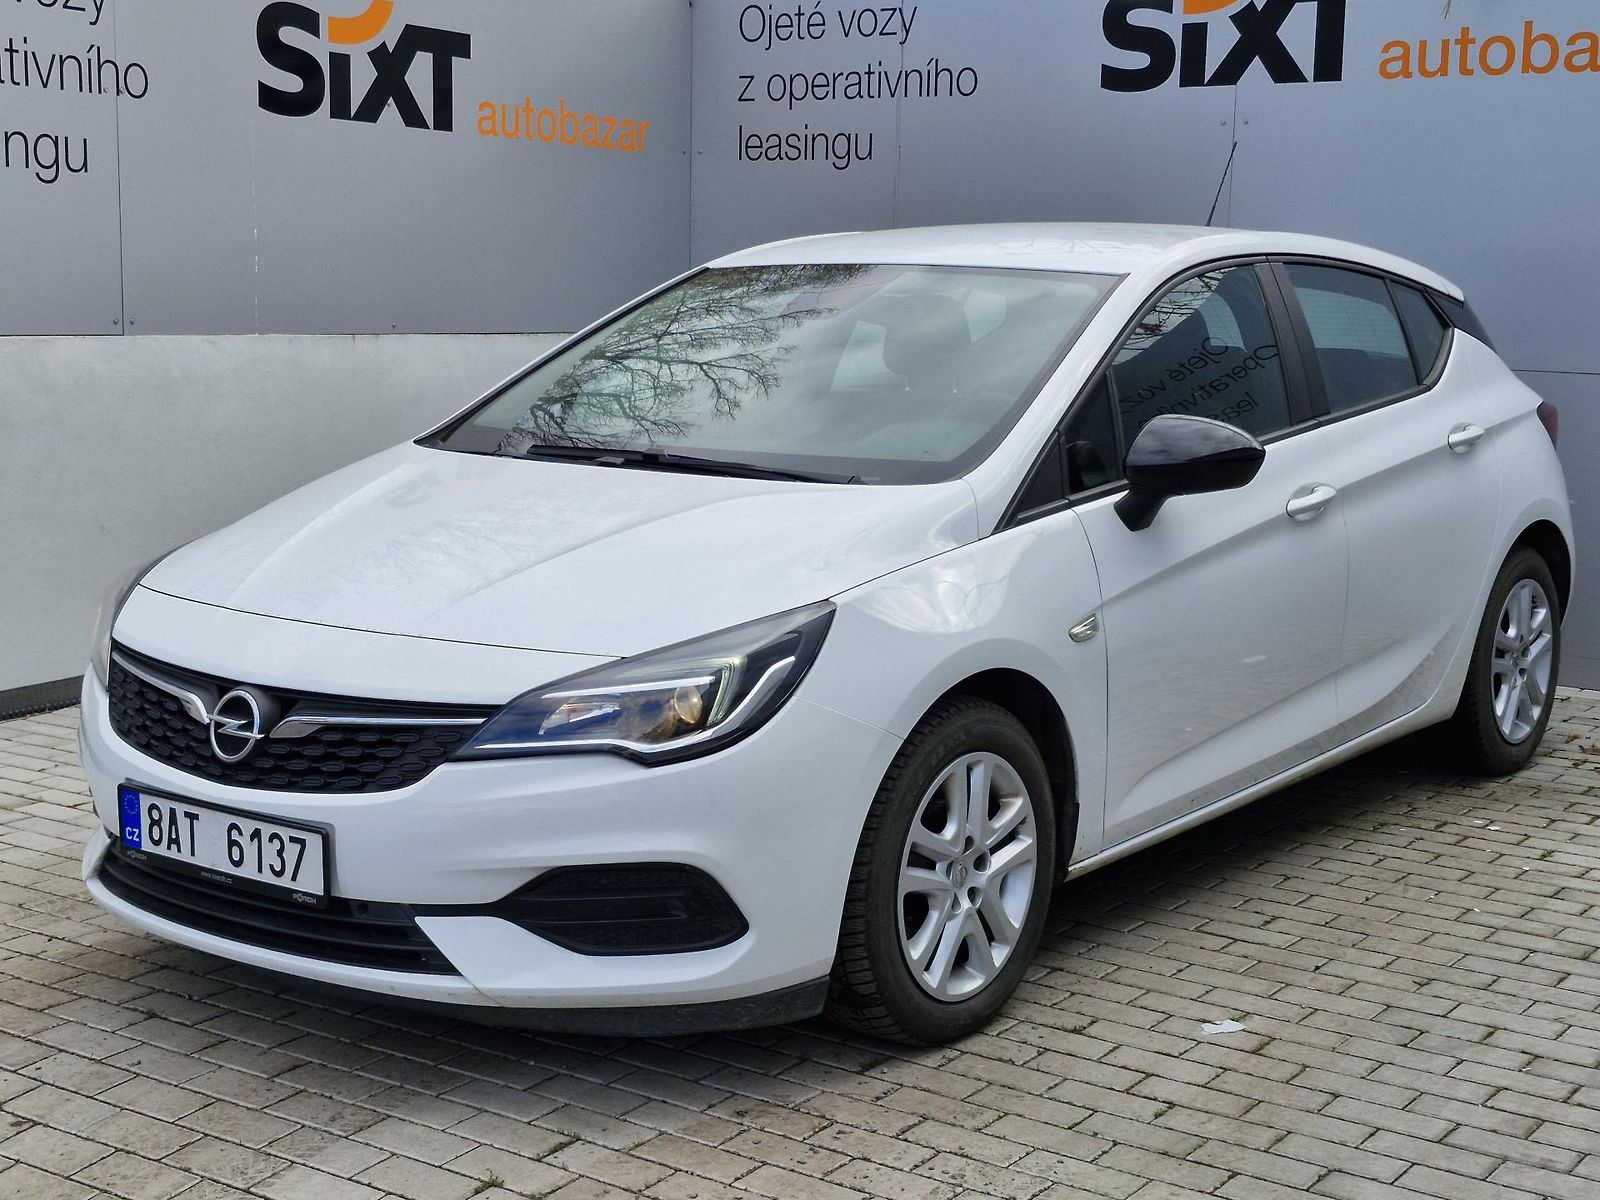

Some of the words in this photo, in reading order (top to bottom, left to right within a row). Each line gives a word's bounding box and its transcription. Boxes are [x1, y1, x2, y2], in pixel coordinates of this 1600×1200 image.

[739, 1, 826, 50] Ojeté
[838, 7, 917, 45] vozy
[0, 37, 148, 99] tivního
[738, 75, 755, 102] z
[767, 58, 978, 110] operativního
[477, 98, 652, 152] autobazar
[738, 124, 873, 170] leasingu
[125, 826, 140, 842] CZ
[147, 802, 200, 857] 8AT
[226, 821, 307, 882] 6137
